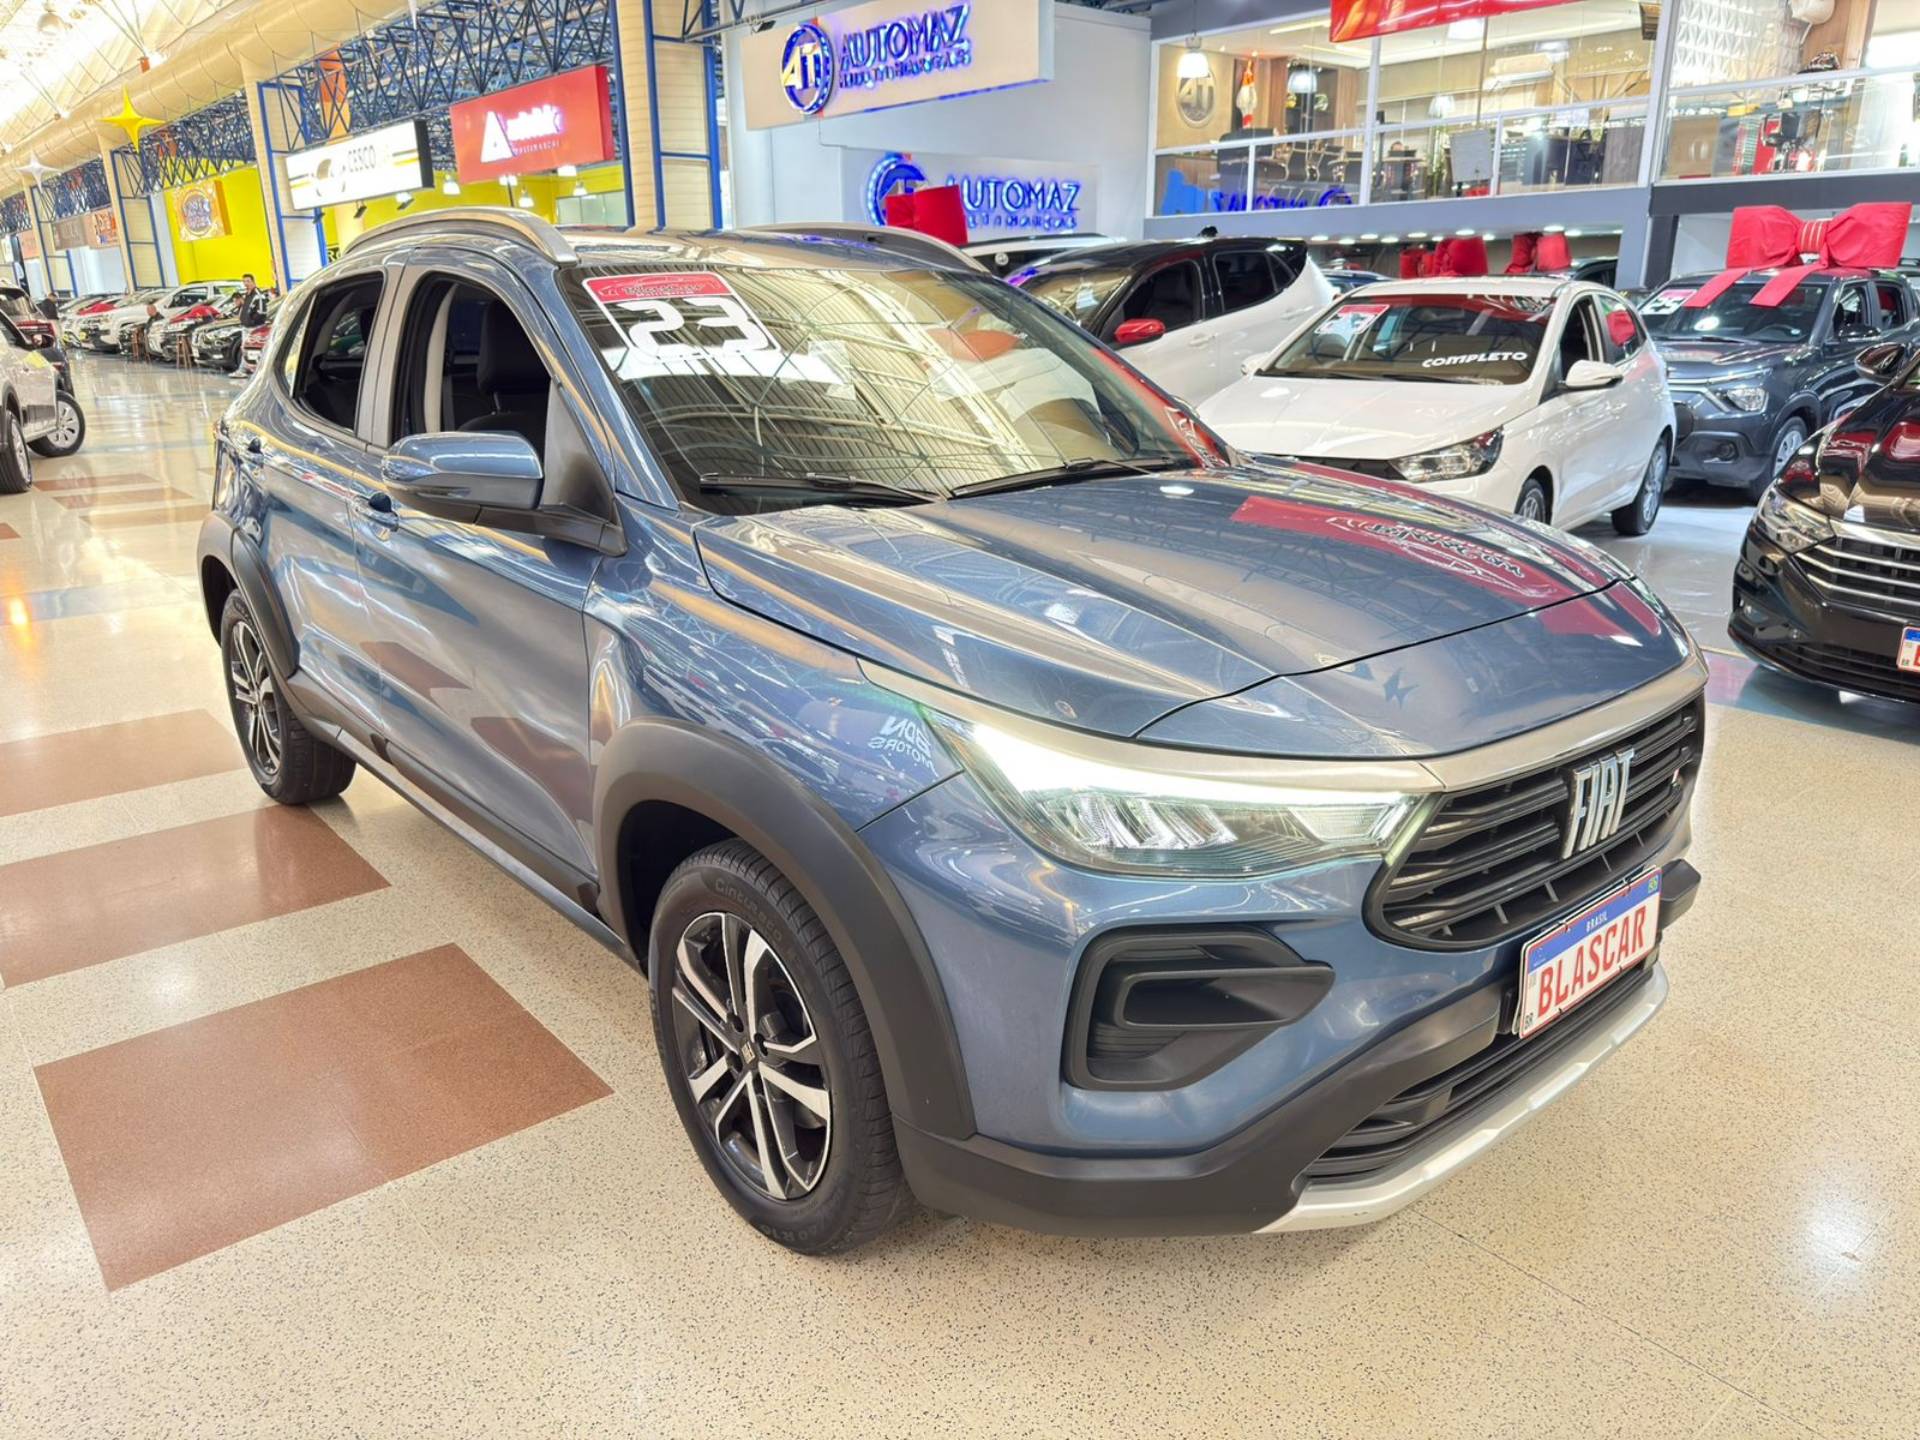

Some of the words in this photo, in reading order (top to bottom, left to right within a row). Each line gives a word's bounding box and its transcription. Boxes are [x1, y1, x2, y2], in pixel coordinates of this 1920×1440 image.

[840, 4, 971, 70] AUTOMAZ
[616, 297, 769, 362] 23
[1422, 351, 1528, 368] COMPLETO
[1562, 747, 1635, 860] FIAT
[1586, 911, 1608, 933] BRASIL
[1537, 905, 1647, 1018] BLASCAR
